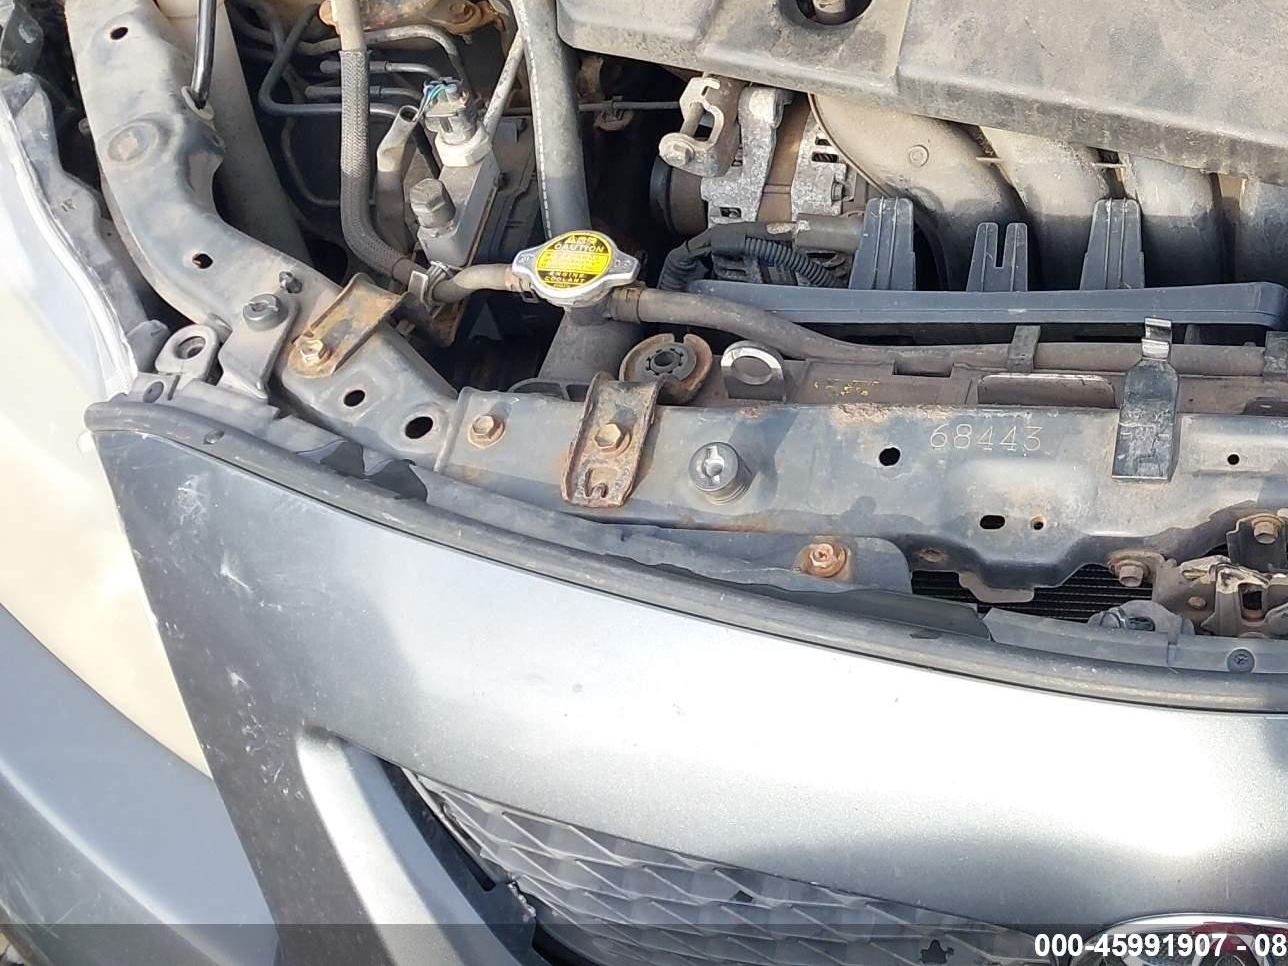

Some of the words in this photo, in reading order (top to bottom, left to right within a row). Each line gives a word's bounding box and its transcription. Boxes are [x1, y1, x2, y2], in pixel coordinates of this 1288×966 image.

[554, 243, 605, 253] CAUTION
[544, 276, 585, 284] COOLANT
[930, 423, 1043, 451] 68443
